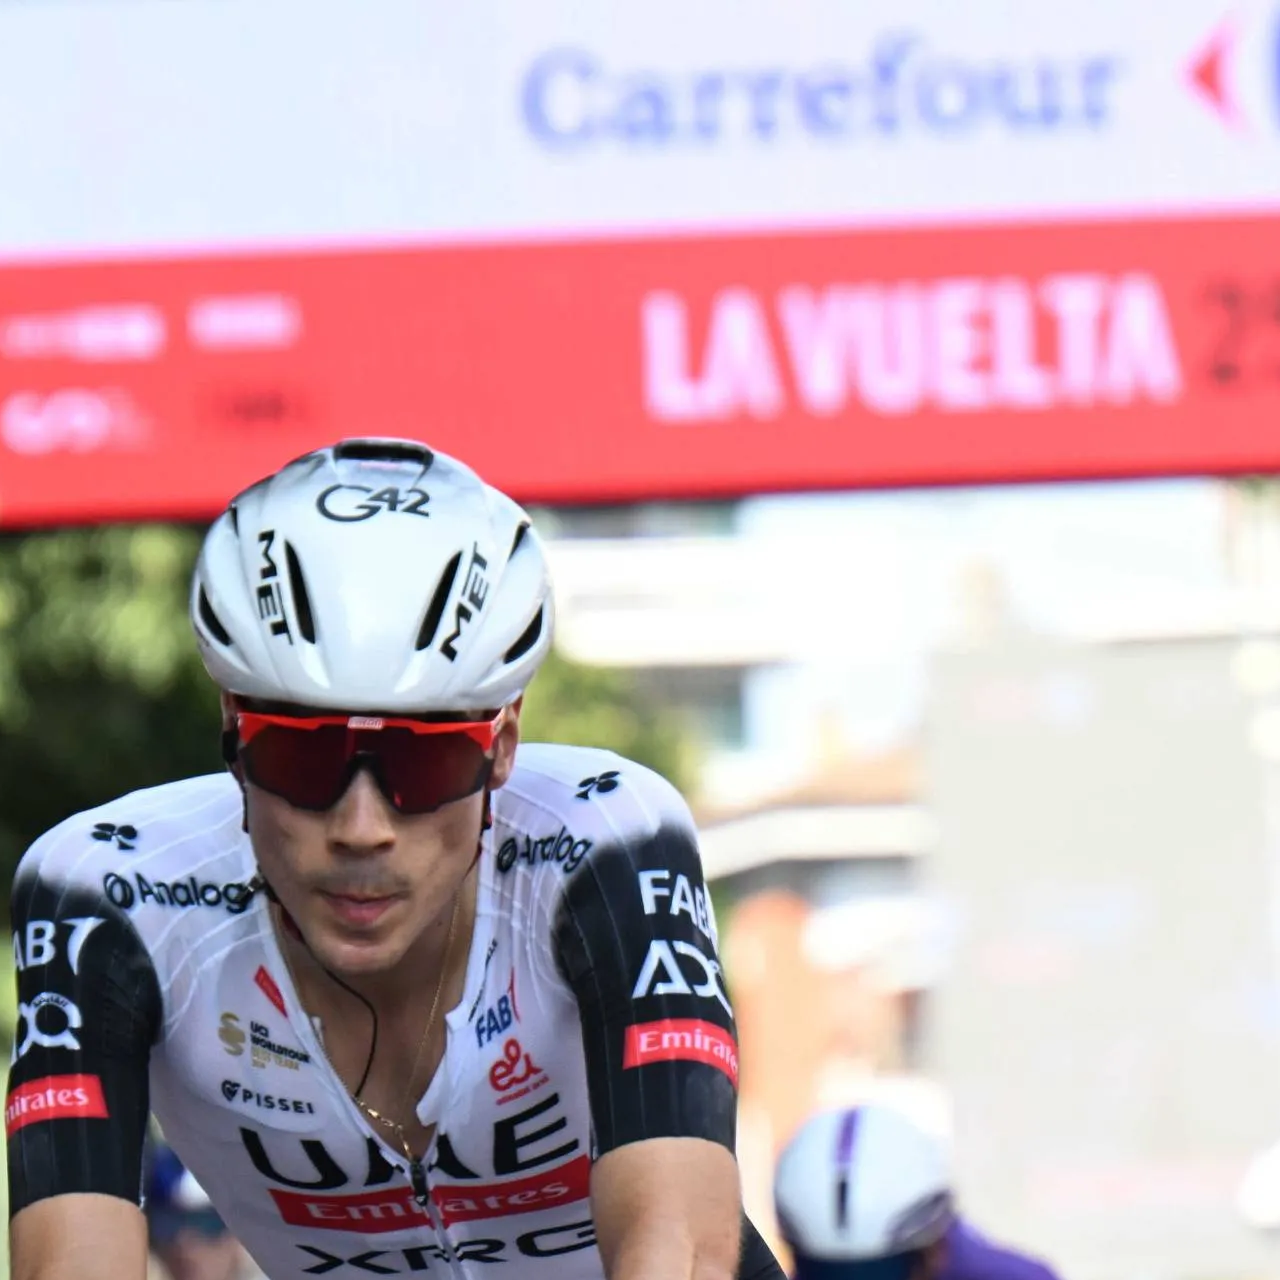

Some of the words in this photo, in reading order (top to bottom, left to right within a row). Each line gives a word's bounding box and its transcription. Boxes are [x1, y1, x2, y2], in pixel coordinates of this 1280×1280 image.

[522, 34, 1120, 150] Carrefour
[642, 290, 780, 421] LA
[780, 273, 1181, 417] VUELTA
[256, 529, 293, 646] MET
[439, 541, 490, 663] MET
[135, 872, 256, 915] Analog
[242, 1089, 315, 1114] PISSEI
